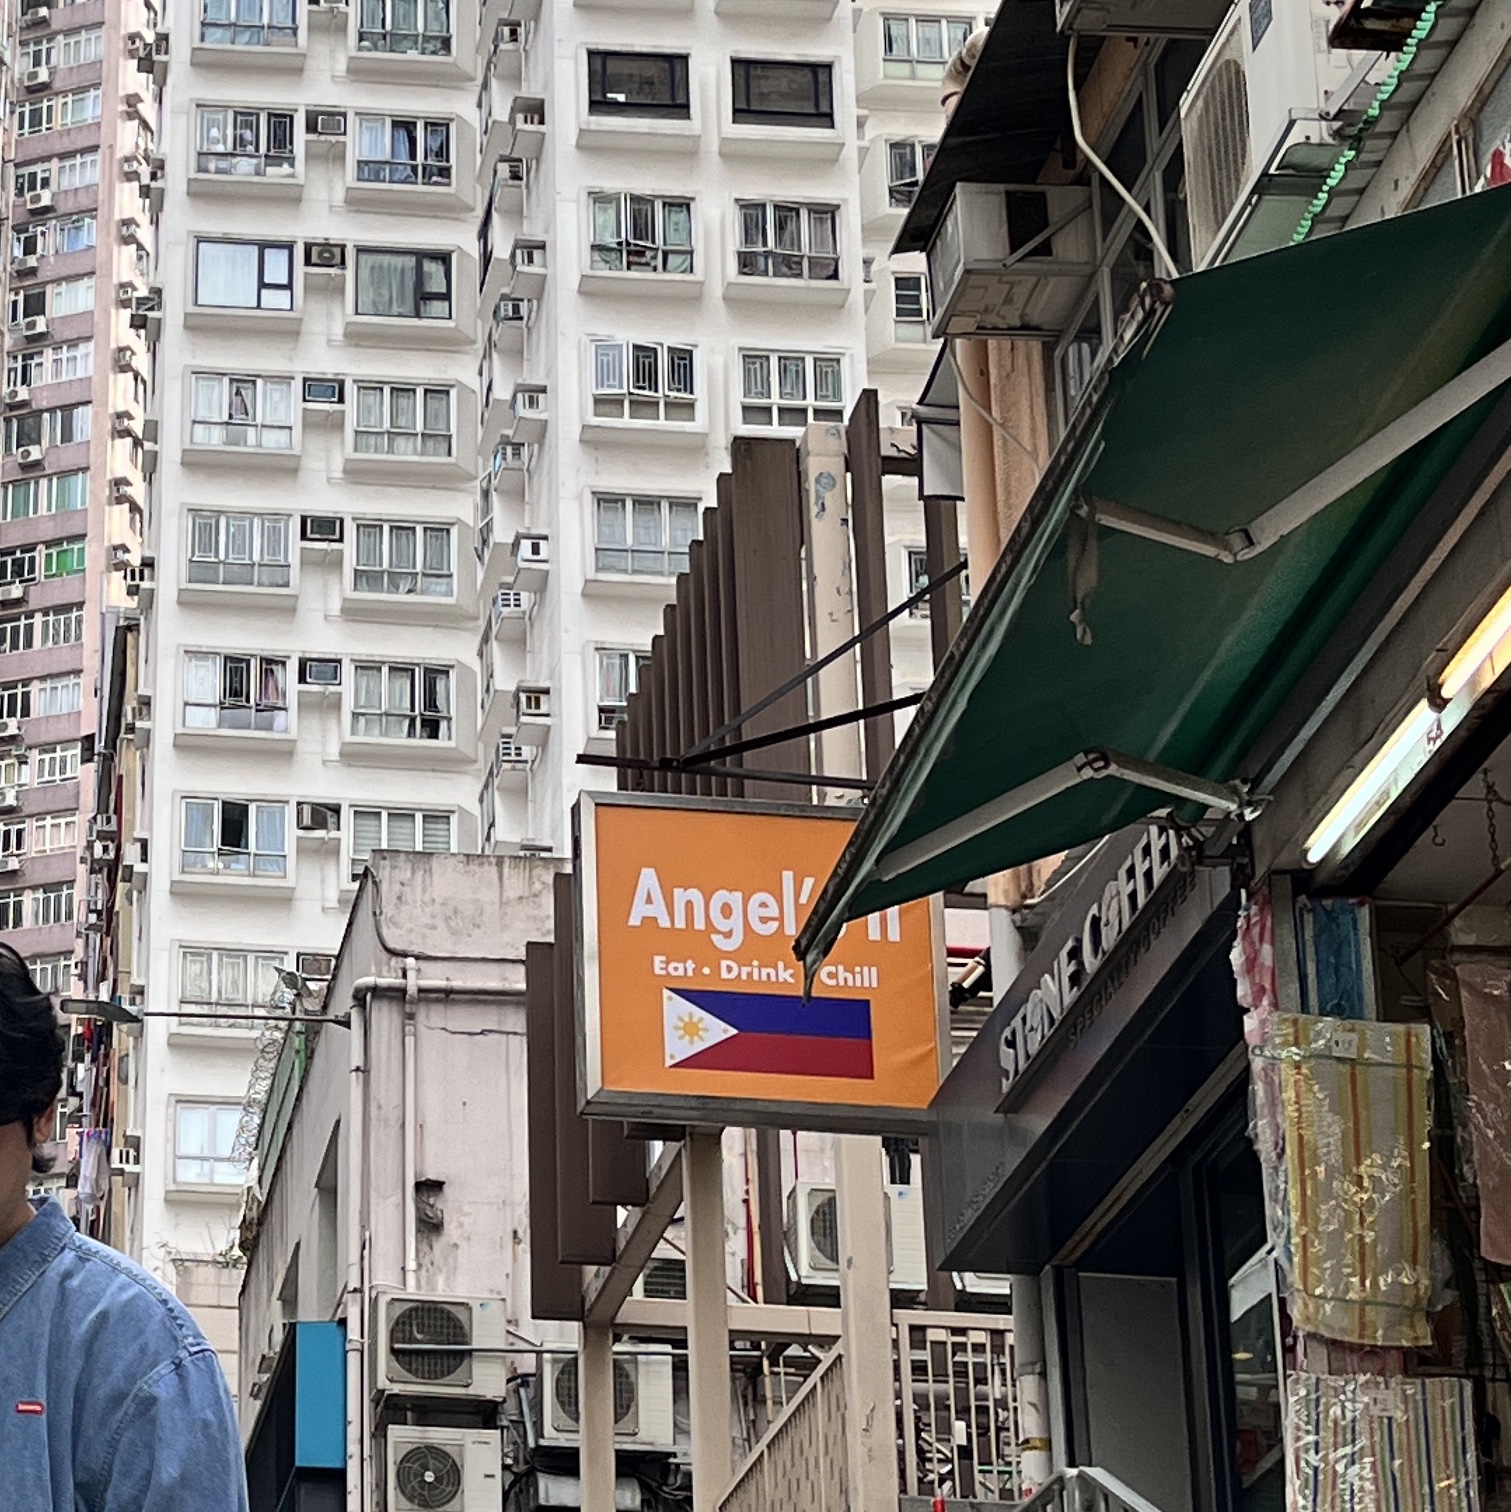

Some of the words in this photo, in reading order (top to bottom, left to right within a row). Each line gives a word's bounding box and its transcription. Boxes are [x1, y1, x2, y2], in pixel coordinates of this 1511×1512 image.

[628, 867, 847, 951] Angel'
[653, 955, 695, 978] Eat
[720, 959, 795, 984] Drink
[820, 965, 878, 988] Chill
[999, 935, 1084, 1095] STONE
